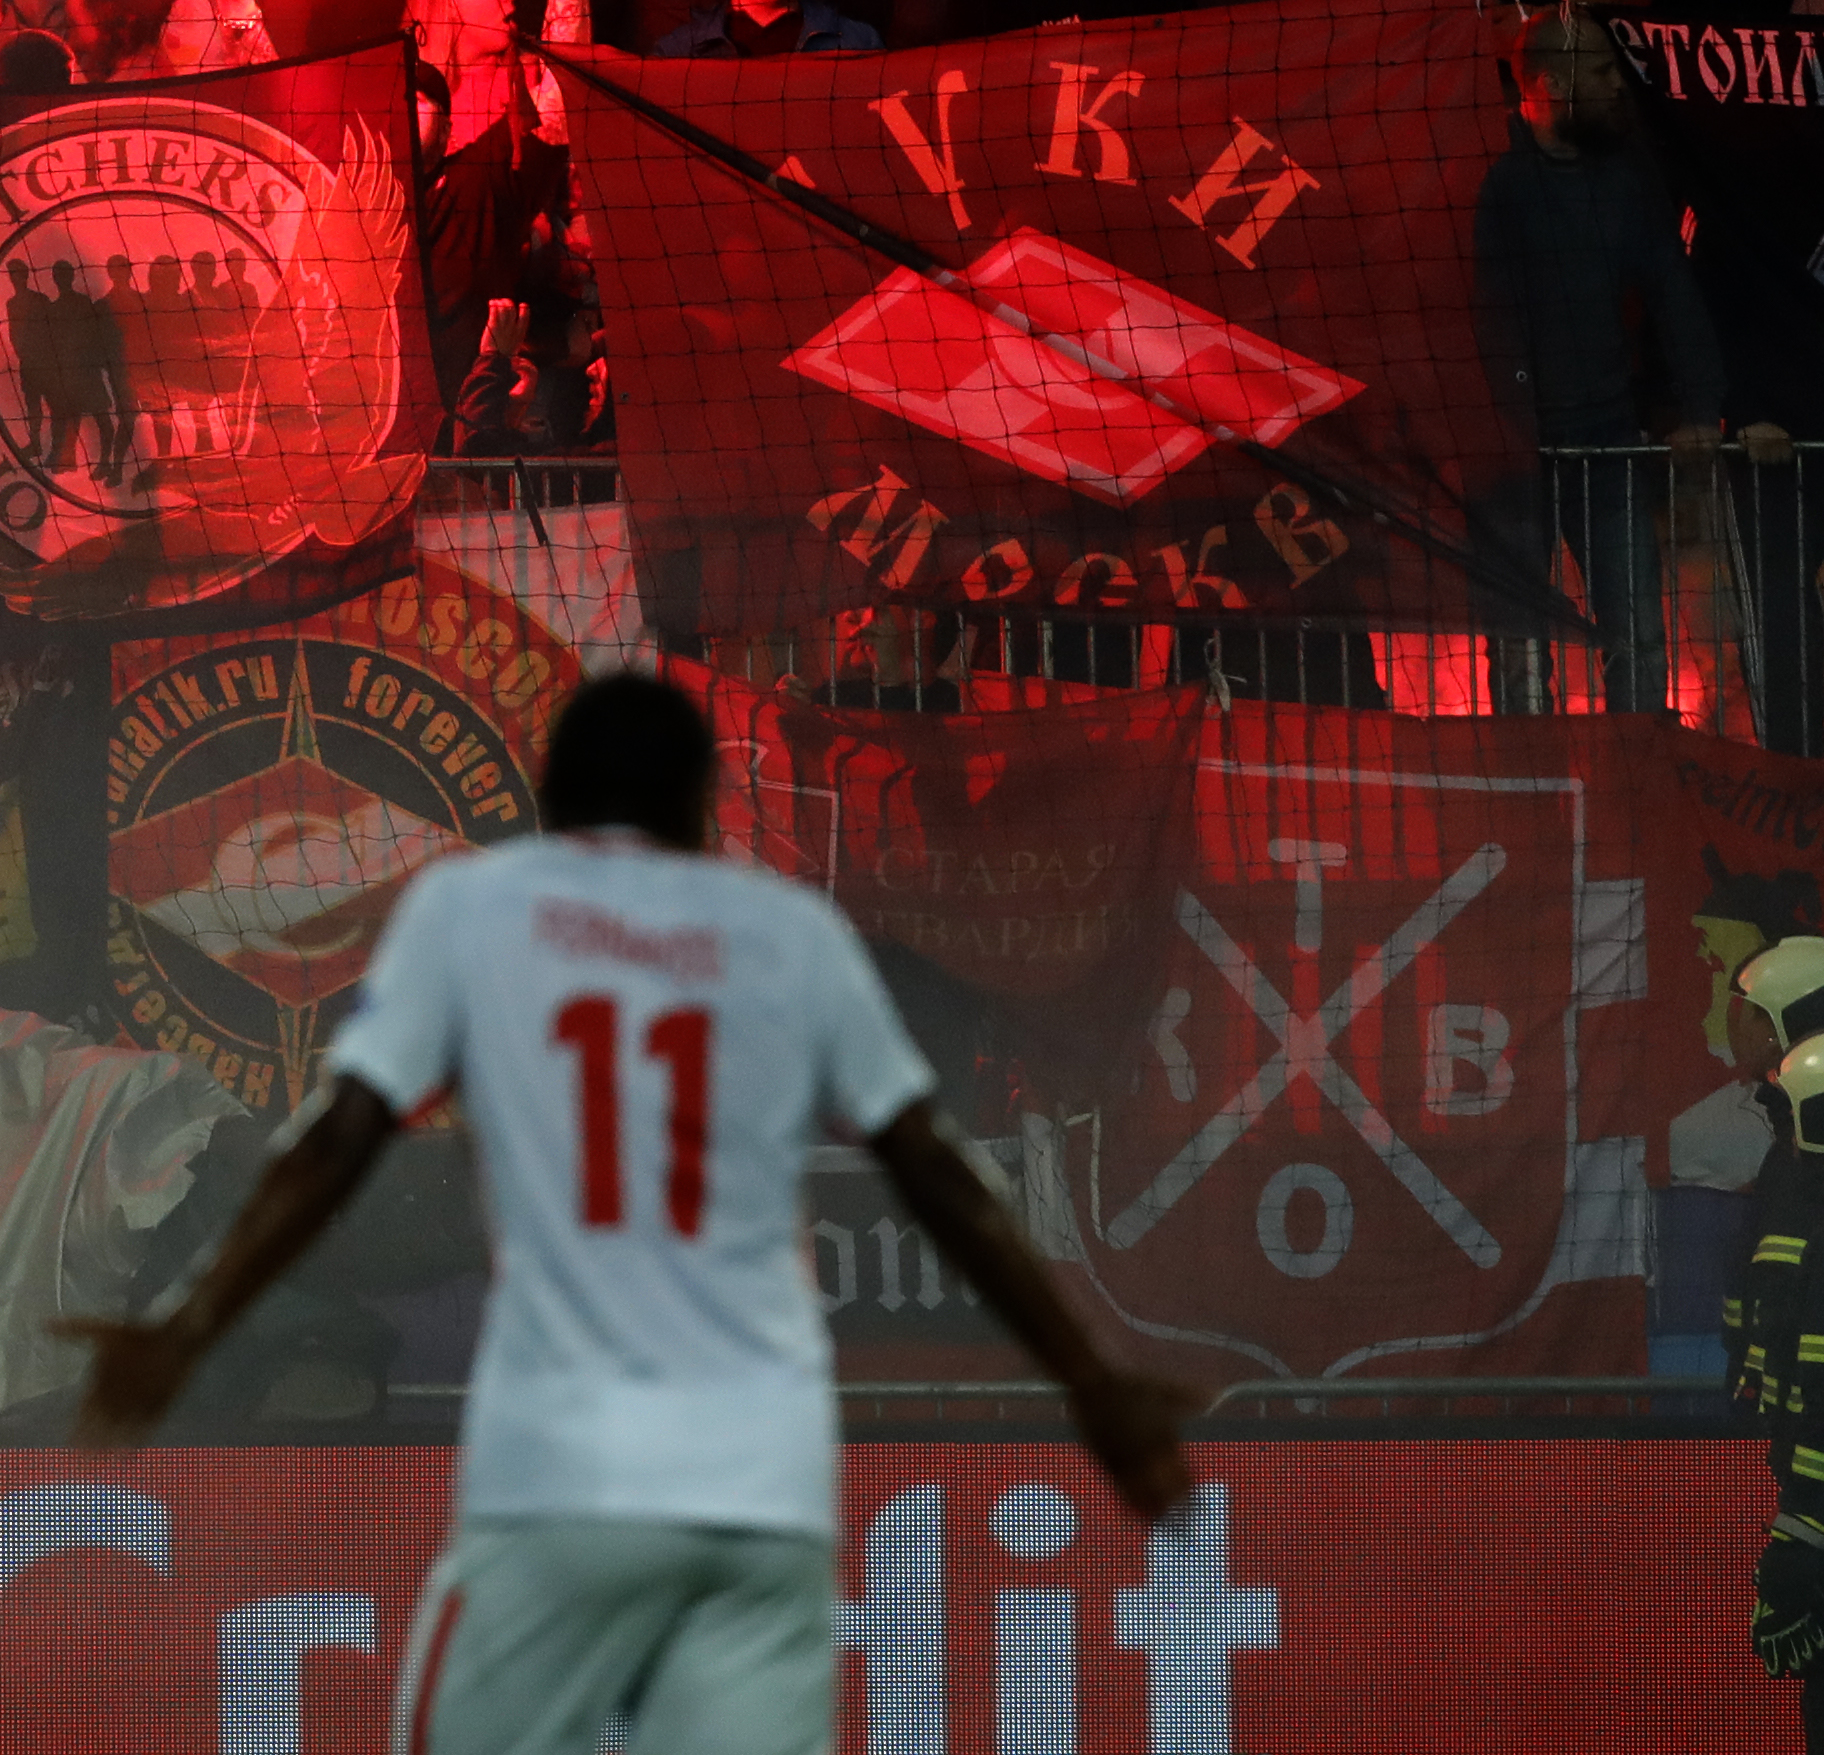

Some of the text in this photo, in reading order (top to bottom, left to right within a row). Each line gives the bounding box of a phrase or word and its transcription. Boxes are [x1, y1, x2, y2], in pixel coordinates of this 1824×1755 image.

[342, 656, 522, 825] forever
[874, 843, 1117, 895] СТАРАЯ
[555, 994, 713, 1239] 11
